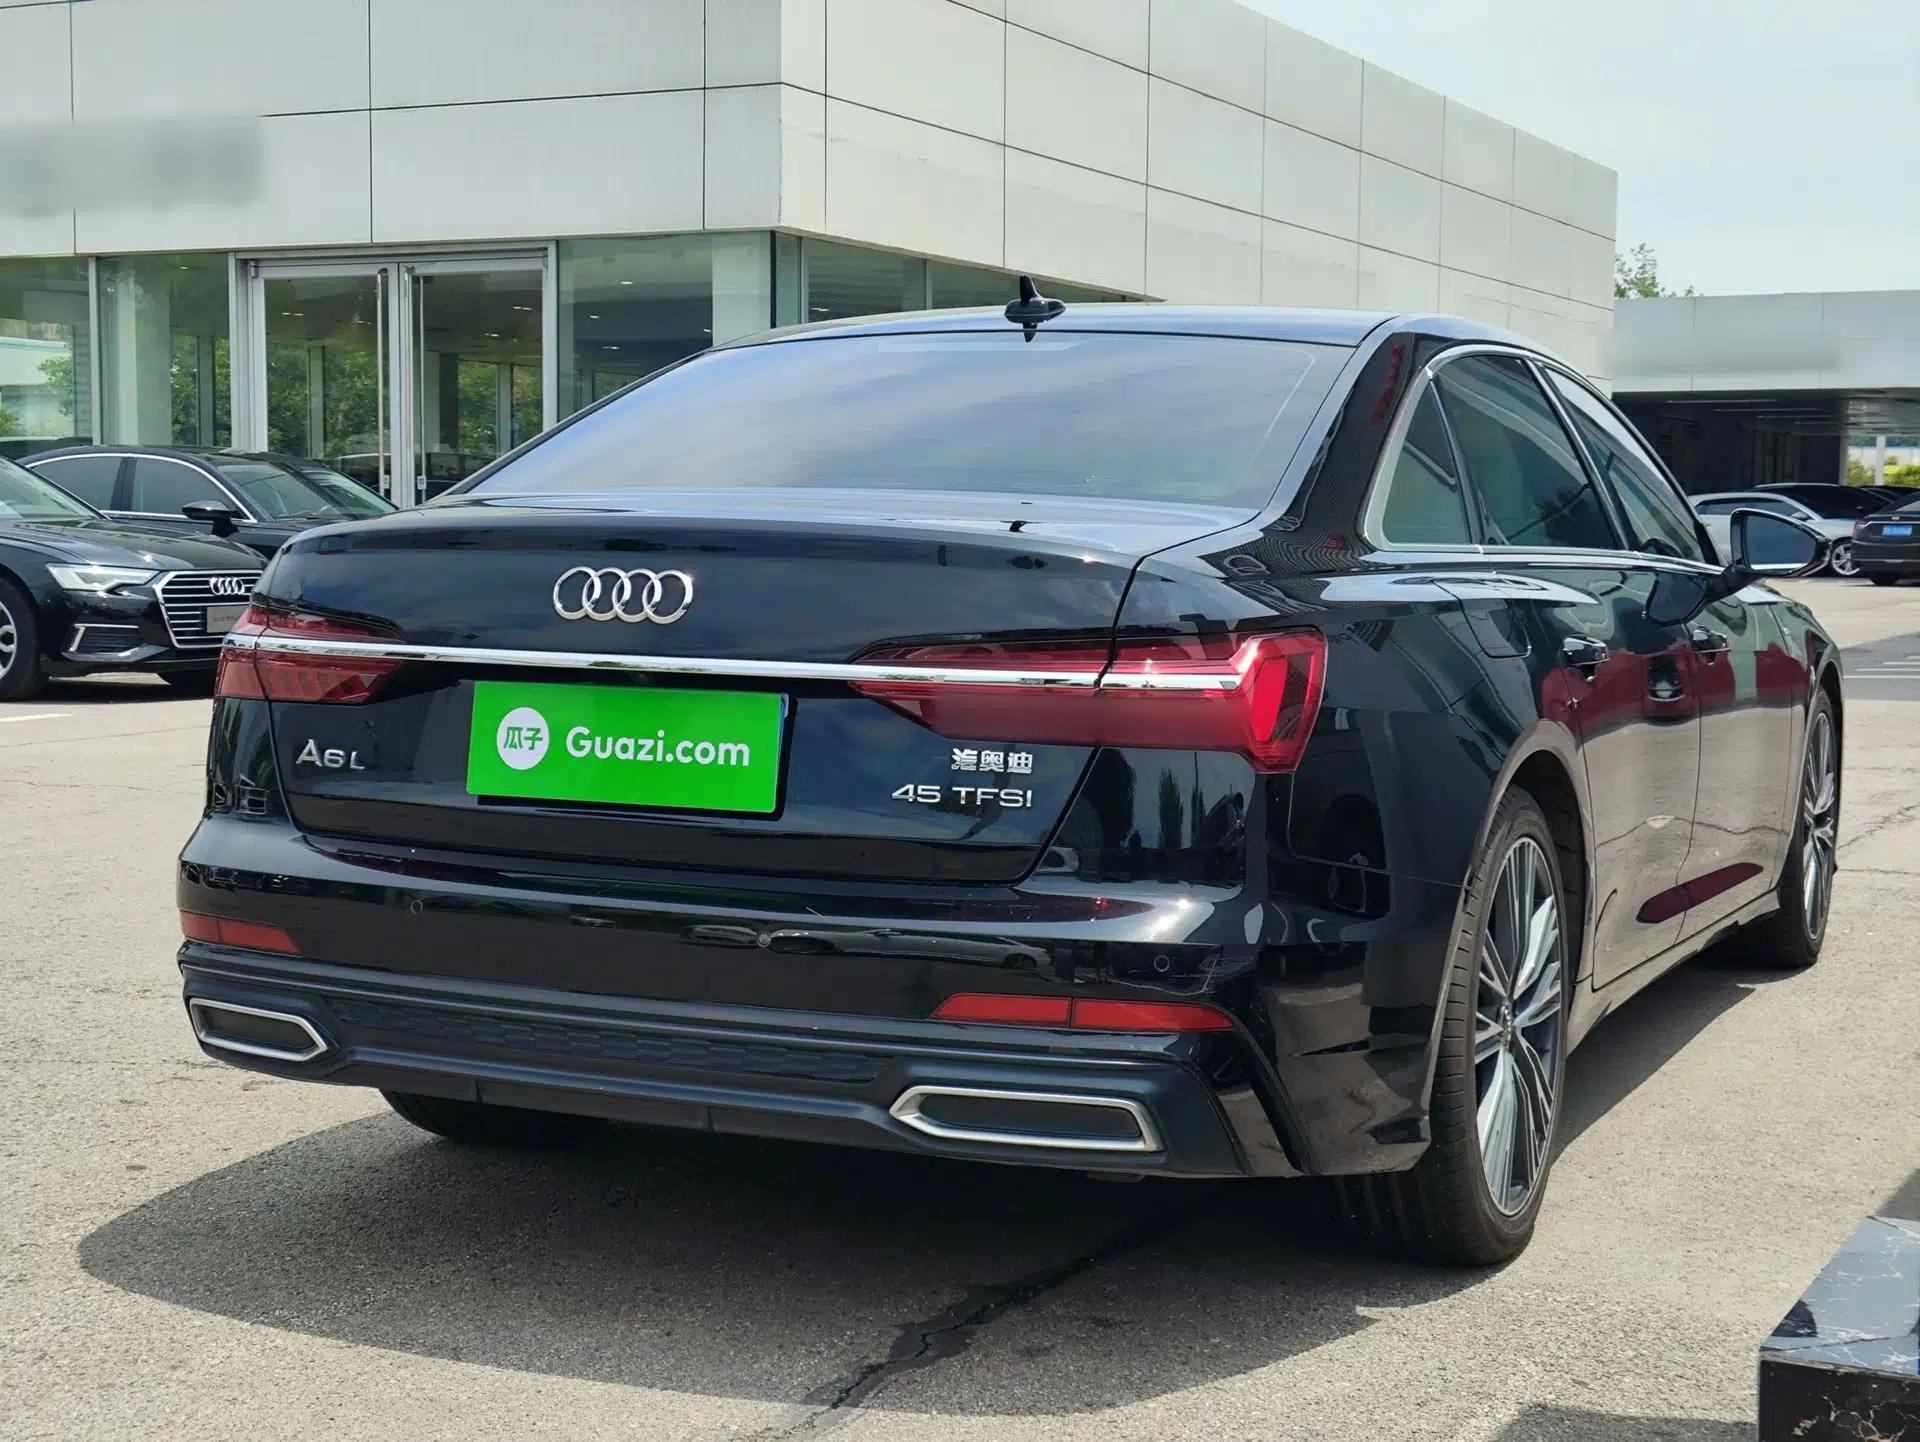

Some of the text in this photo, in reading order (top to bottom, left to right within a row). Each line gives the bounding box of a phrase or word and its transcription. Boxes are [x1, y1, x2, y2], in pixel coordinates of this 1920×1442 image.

[503, 726, 543, 751] 瓜子
[566, 726, 750, 766] Guazi.com
[296, 739, 365, 769] A6L
[892, 784, 1033, 808] 45 TFSI
